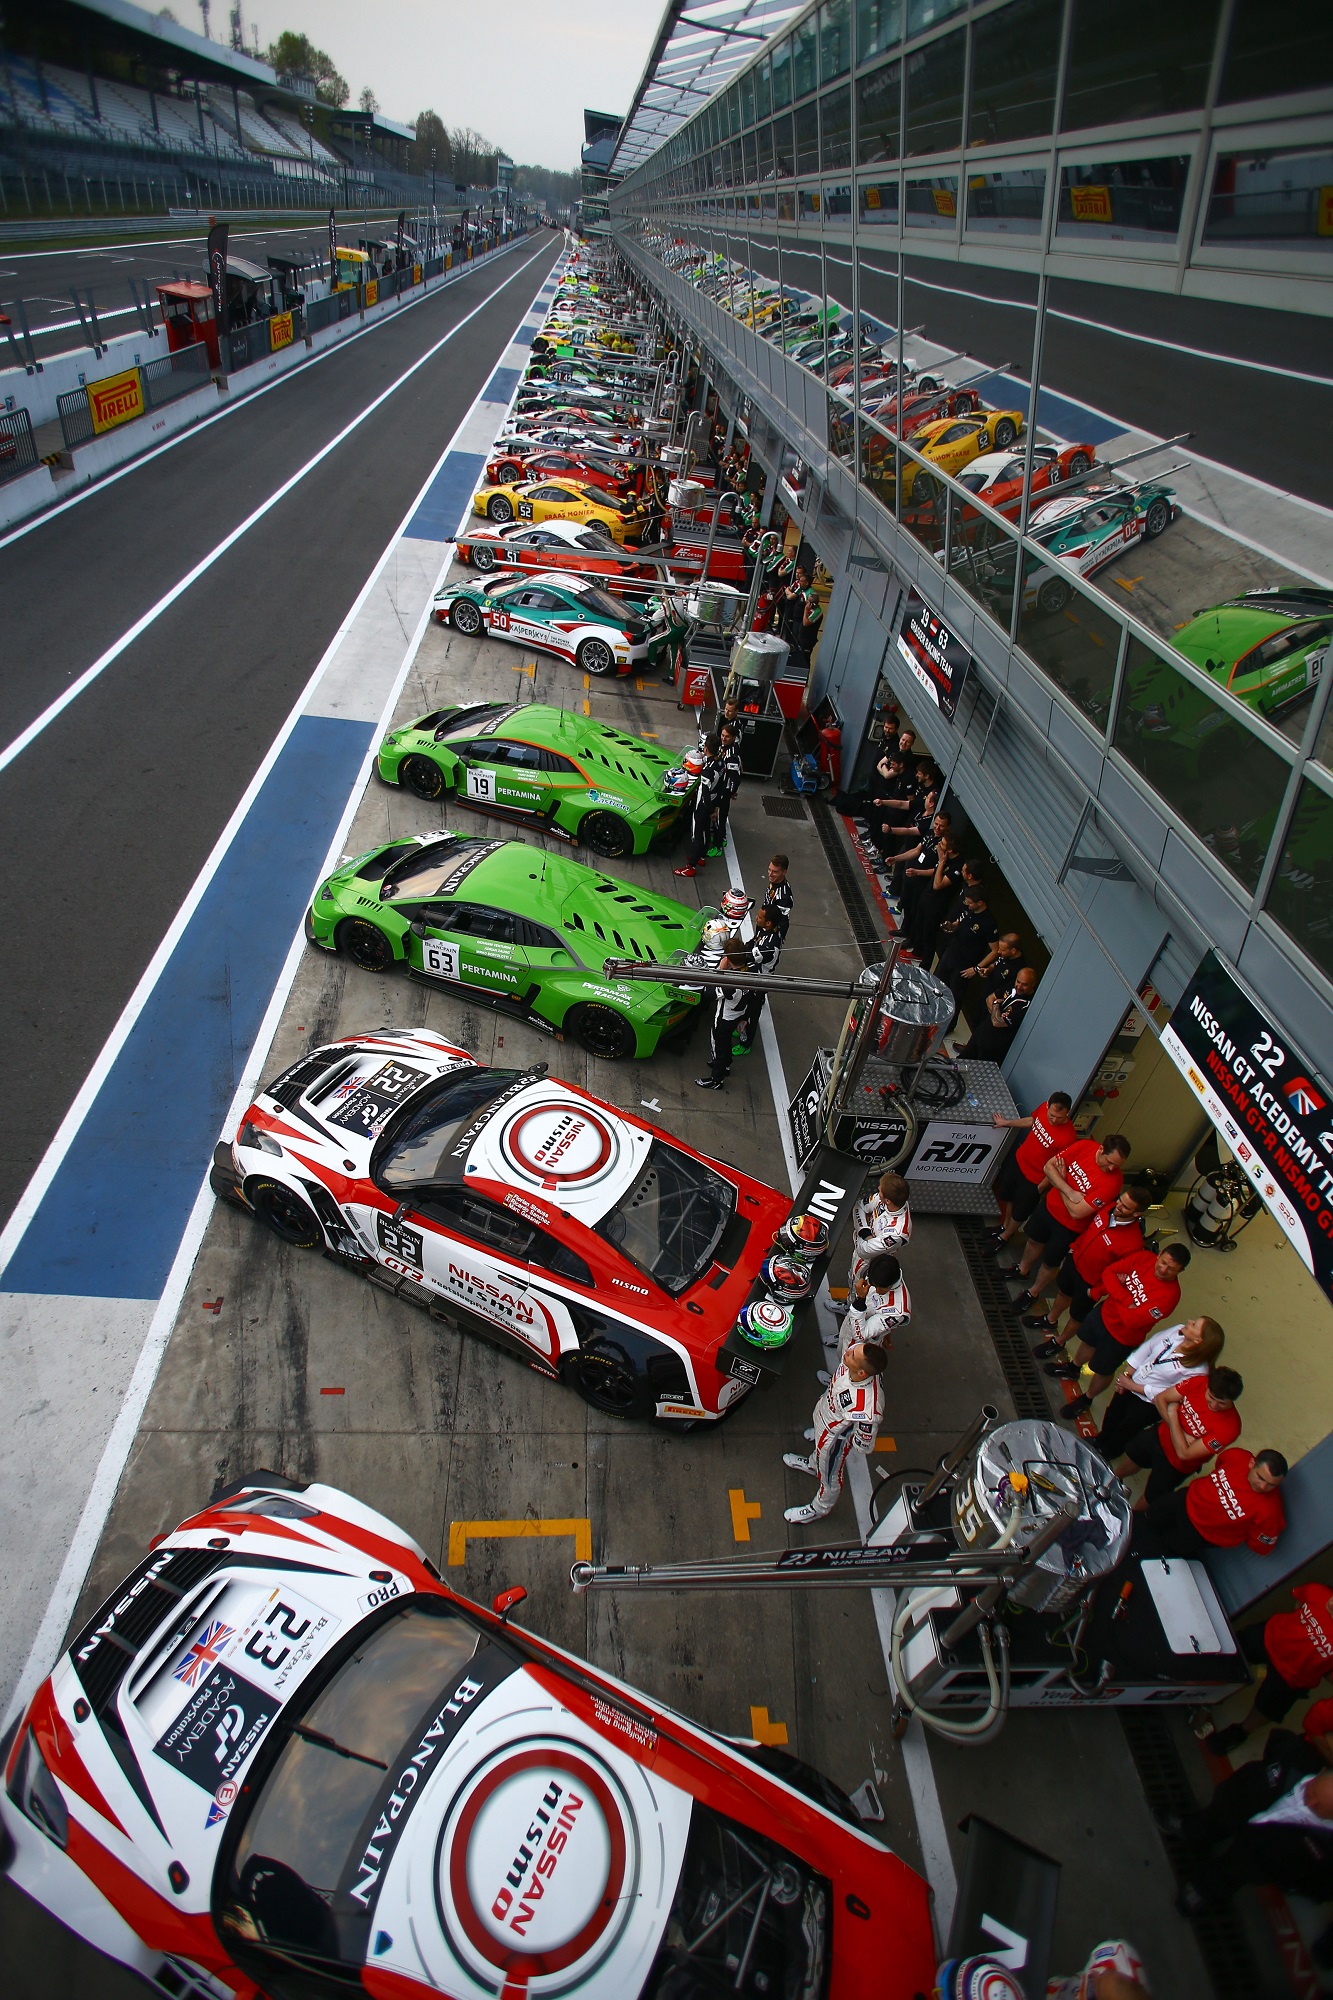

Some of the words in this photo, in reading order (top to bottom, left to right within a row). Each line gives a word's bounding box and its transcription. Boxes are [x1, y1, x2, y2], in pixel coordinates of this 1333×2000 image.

[573, 333, 585, 345] 44
[553, 372, 561, 381] 41
[94, 379, 139, 423] PIRELLI
[660, 407, 669, 418] 42
[526, 471, 538, 481] 53
[520, 505, 531, 517] 52
[544, 512, 566, 520] BRAAS
[567, 509, 595, 517] MONIER
[507, 550, 517, 563] 51
[492, 612, 507, 629] 50
[510, 623, 544, 641] KASPERSKY
[920, 608, 930, 628] 19
[938, 628, 949, 650] 63
[924, 638, 940, 664] RACING
[939, 652, 954, 679] TEAM
[473, 776, 489, 795] 19
[497, 787, 541, 801] PERTAMINA
[441, 841, 507, 893] BLANCPAIN
[424, 941, 457, 954] BLANCPAIN
[428, 950, 454, 973] 63
[461, 962, 518, 984] PERTAMINA
[582, 981, 633, 1001] PERTAMAX
[593, 989, 631, 1007] RACING
[438, 1061, 473, 1073] PRO-AM
[1250, 1030, 1286, 1079] 22
[269, 1051, 322, 1094] NISSAN
[371, 1066, 413, 1093] 22
[518, 1074, 539, 1085] 22
[1188, 1069, 1205, 1092] PIRELLI
[1189, 995, 1237, 1064] NISSAN
[1232, 1056, 1256, 1085] GT
[1249, 1081, 1321, 1175] ACEDEMY
[393, 1072, 426, 1101] BLANCPAIN
[339, 1093, 372, 1124] ACADEMY
[367, 1106, 393, 1131] NISSAN
[450, 1083, 523, 1159] BLANCPAIN
[534, 1115, 574, 1162] nismo
[855, 1121, 908, 1132] NISSAN
[951, 1132, 977, 1140] TEAM
[1034, 1117, 1054, 1145] NISSAN
[1205, 1049, 1251, 1114] NISSAN
[1245, 1106, 1278, 1152] GT-R
[1272, 1145, 1321, 1212] NISMO
[544, 1120, 586, 1168] NISSAN
[915, 1164, 980, 1175] MOTORSPORT
[1071, 1160, 1092, 1191] NISSAN
[508, 1202, 521, 1214] Marc
[379, 1218, 421, 1245] BLANCPAIN
[384, 1228, 417, 1264] 22
[384, 1256, 424, 1284] GT3
[448, 1263, 534, 1318] NISSAN
[611, 1277, 649, 1296] nismo
[449, 1276, 534, 1325] nismo
[531, 1363, 557, 1379] MOTUL
[666, 1406, 704, 1417] PIRELLI
[1181, 1395, 1207, 1436] NISSAN
[1217, 1467, 1246, 1518] NISSAN
[955, 1477, 984, 1543] 35
[779, 1552, 819, 1567] 23
[821, 1547, 912, 1560] NISSAN
[76, 1551, 176, 1661] NISSAN
[366, 1582, 401, 1607] PRO
[244, 1601, 312, 1671] 23
[1301, 1602, 1333, 1657] NISSAN
[273, 1616, 329, 1690] BLANCPAIN
[164, 1687, 213, 1748] PlayStation
[176, 1677, 237, 1763] ACADEMY
[594, 1702, 633, 1730] Buncombe
[595, 1710, 612, 1726] Reip
[221, 1712, 269, 1778] NISSAN
[612, 1719, 646, 1746] Wolfgang
[634, 1725, 651, 1739] Alex
[348, 1674, 486, 1910] BLANCPAIN
[490, 1779, 564, 1922] nismo
[509, 1791, 584, 1938] NISSAN
